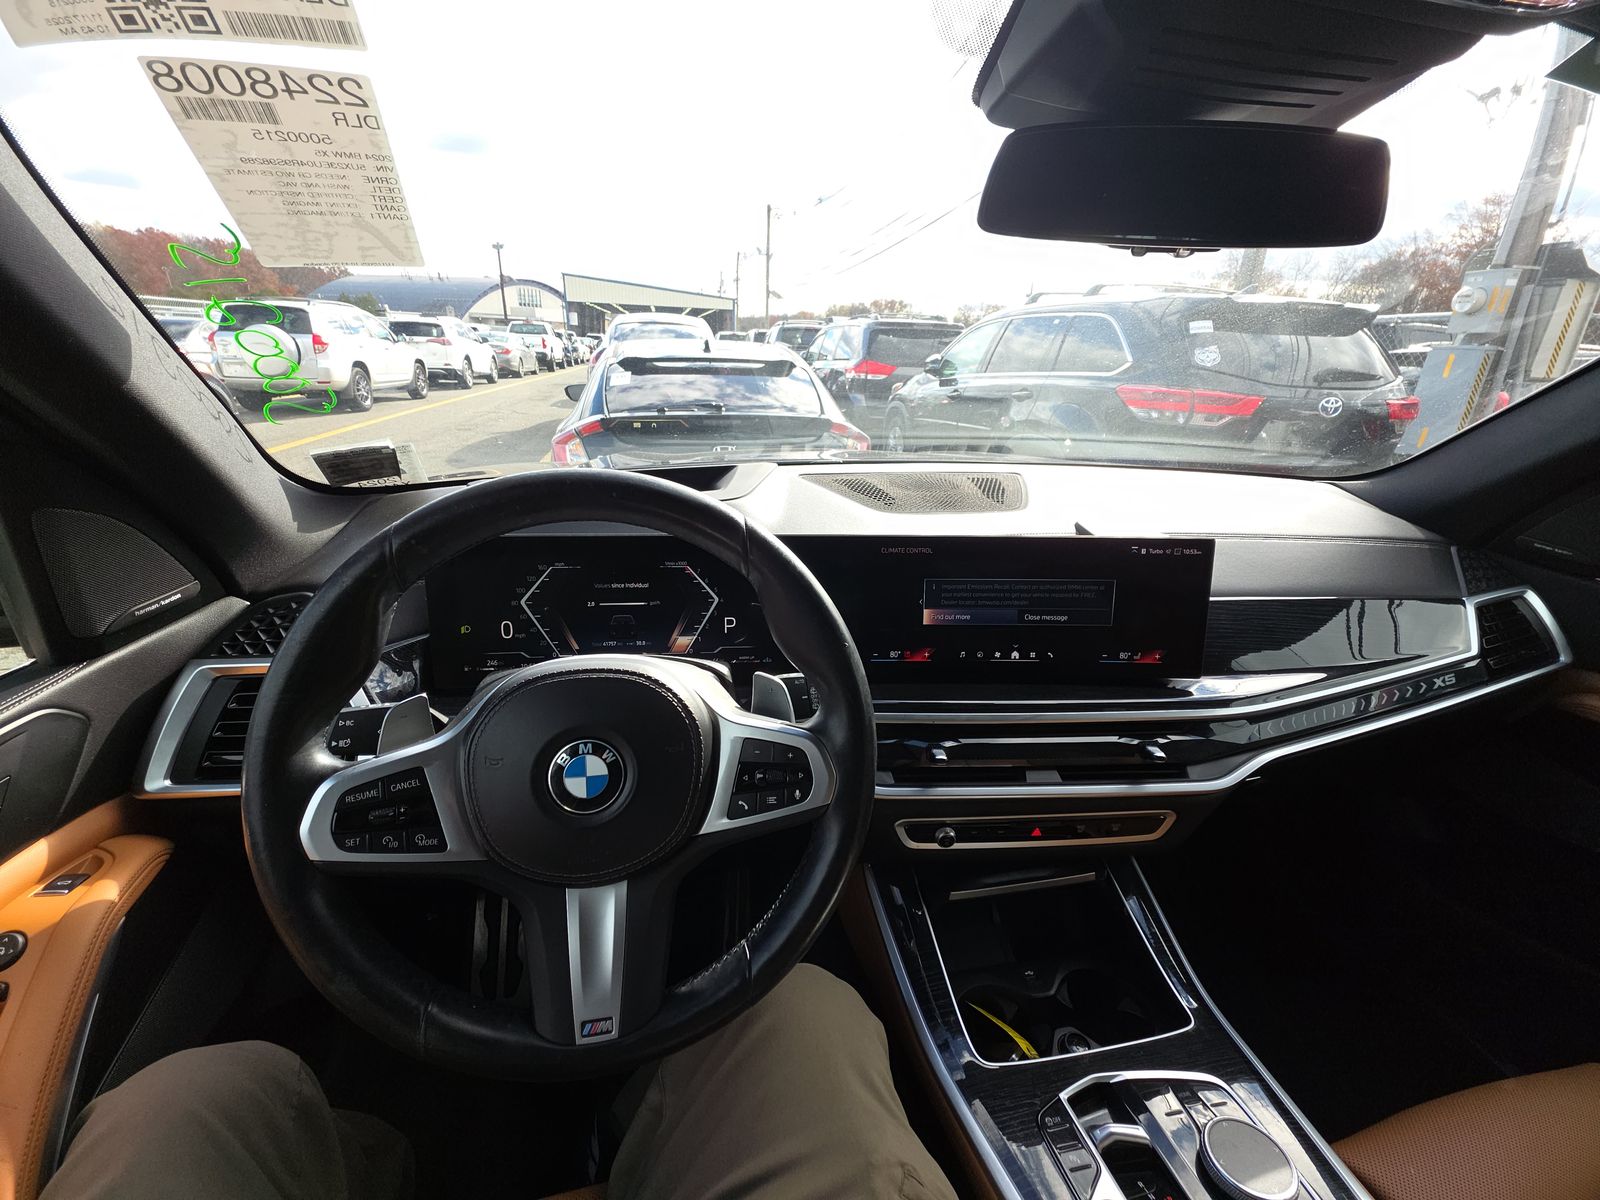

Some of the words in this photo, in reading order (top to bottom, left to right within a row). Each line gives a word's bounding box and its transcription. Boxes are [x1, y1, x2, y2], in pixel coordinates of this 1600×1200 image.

[724, 616, 737, 634] P
[1432, 673, 1456, 690] X5
[556, 742, 617, 768] BMW
[345, 788, 380, 804] RESUME
[390, 778, 421, 793] CANCEL
[345, 837, 361, 847] SET
[418, 837, 439, 847] MODE
